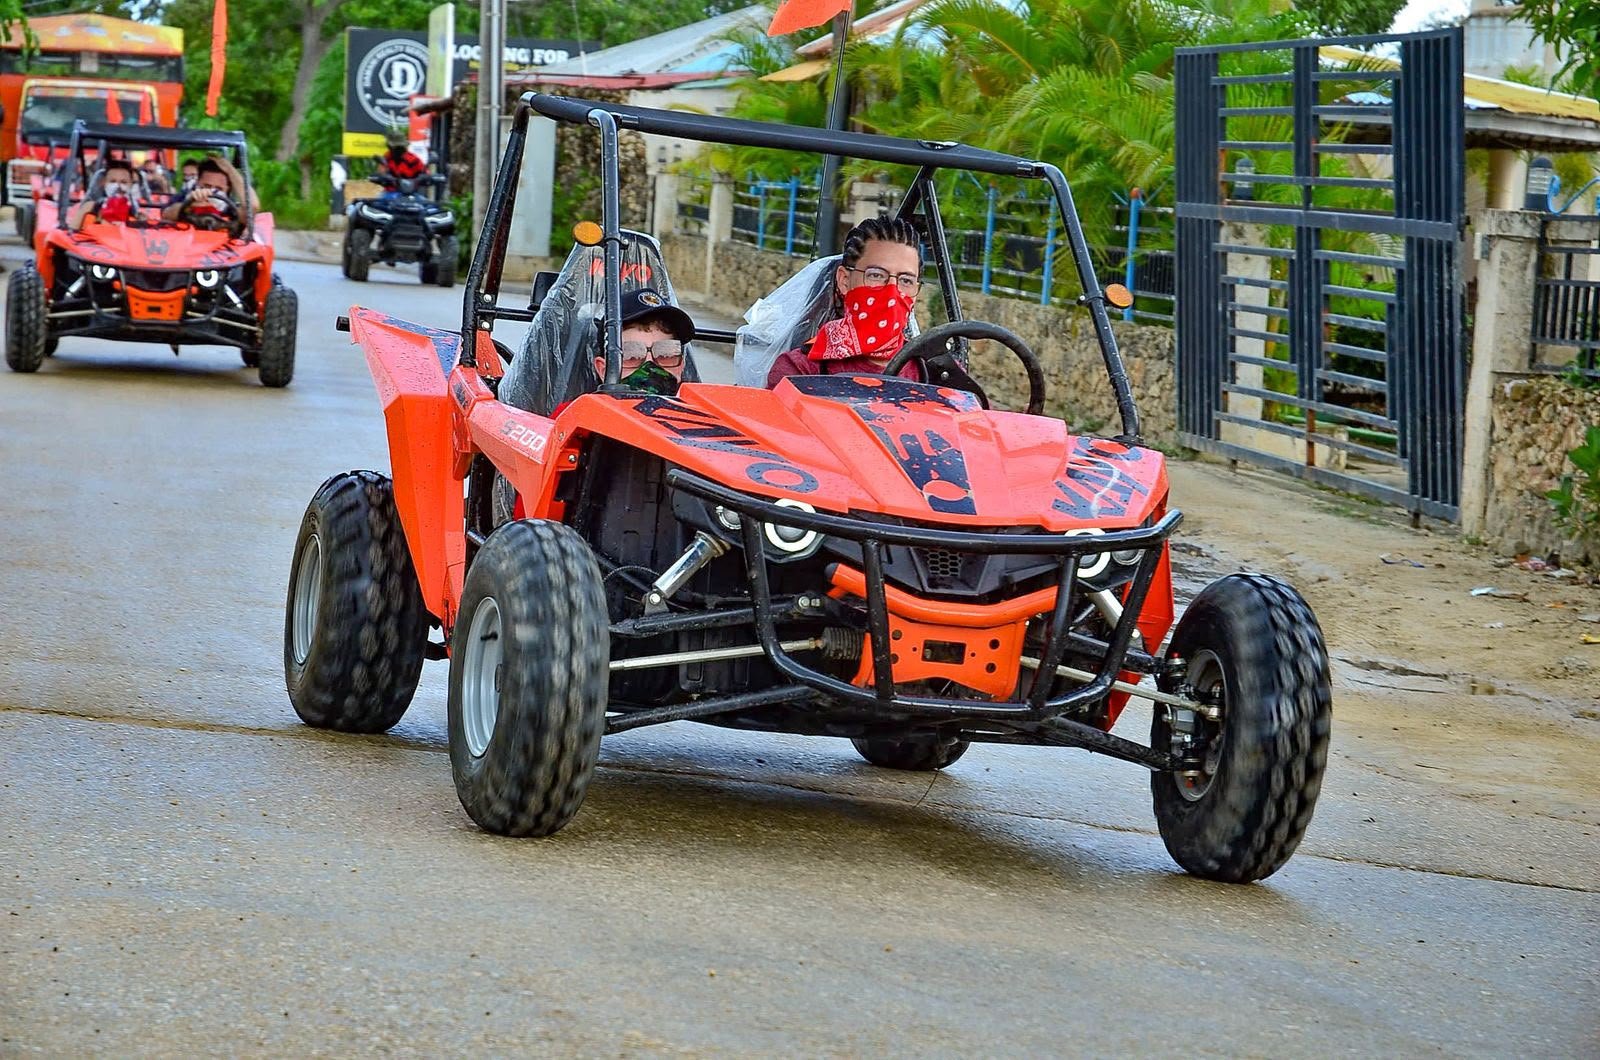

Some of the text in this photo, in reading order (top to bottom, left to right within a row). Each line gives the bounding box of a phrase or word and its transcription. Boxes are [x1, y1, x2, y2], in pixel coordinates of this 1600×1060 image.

[452, 44, 568, 64] LOONG FOR
[390, 60, 418, 92] D
[501, 419, 547, 451] S200
